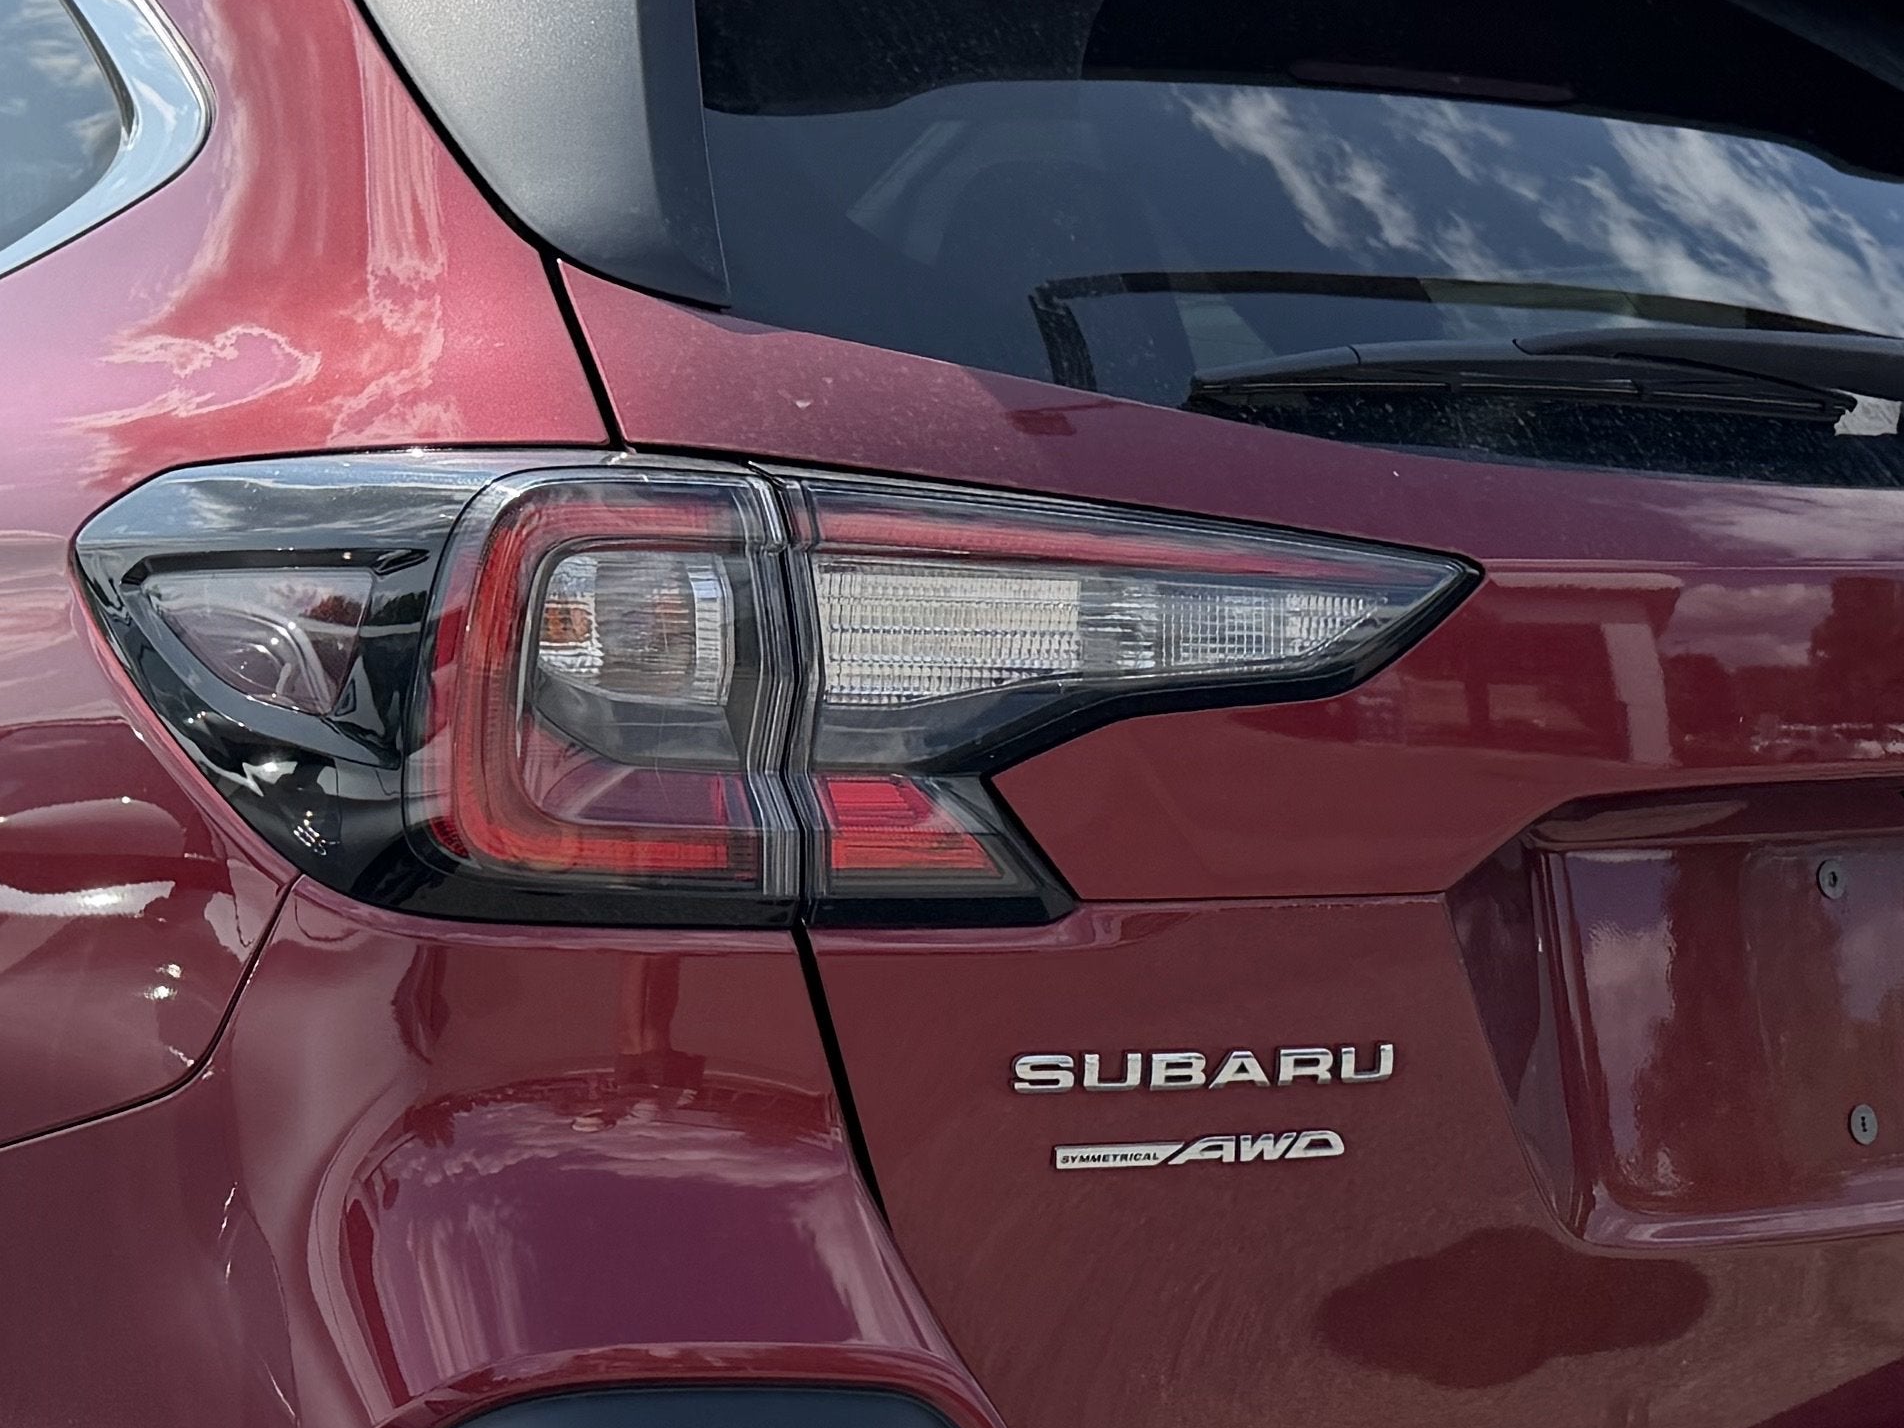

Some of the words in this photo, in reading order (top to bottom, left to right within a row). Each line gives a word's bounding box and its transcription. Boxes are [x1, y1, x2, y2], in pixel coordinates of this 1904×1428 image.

[1013, 1043, 1394, 1094] SUBARU
[1061, 1152, 1160, 1165] SYMMETRICAL
[1168, 1130, 1345, 1165] AWD
